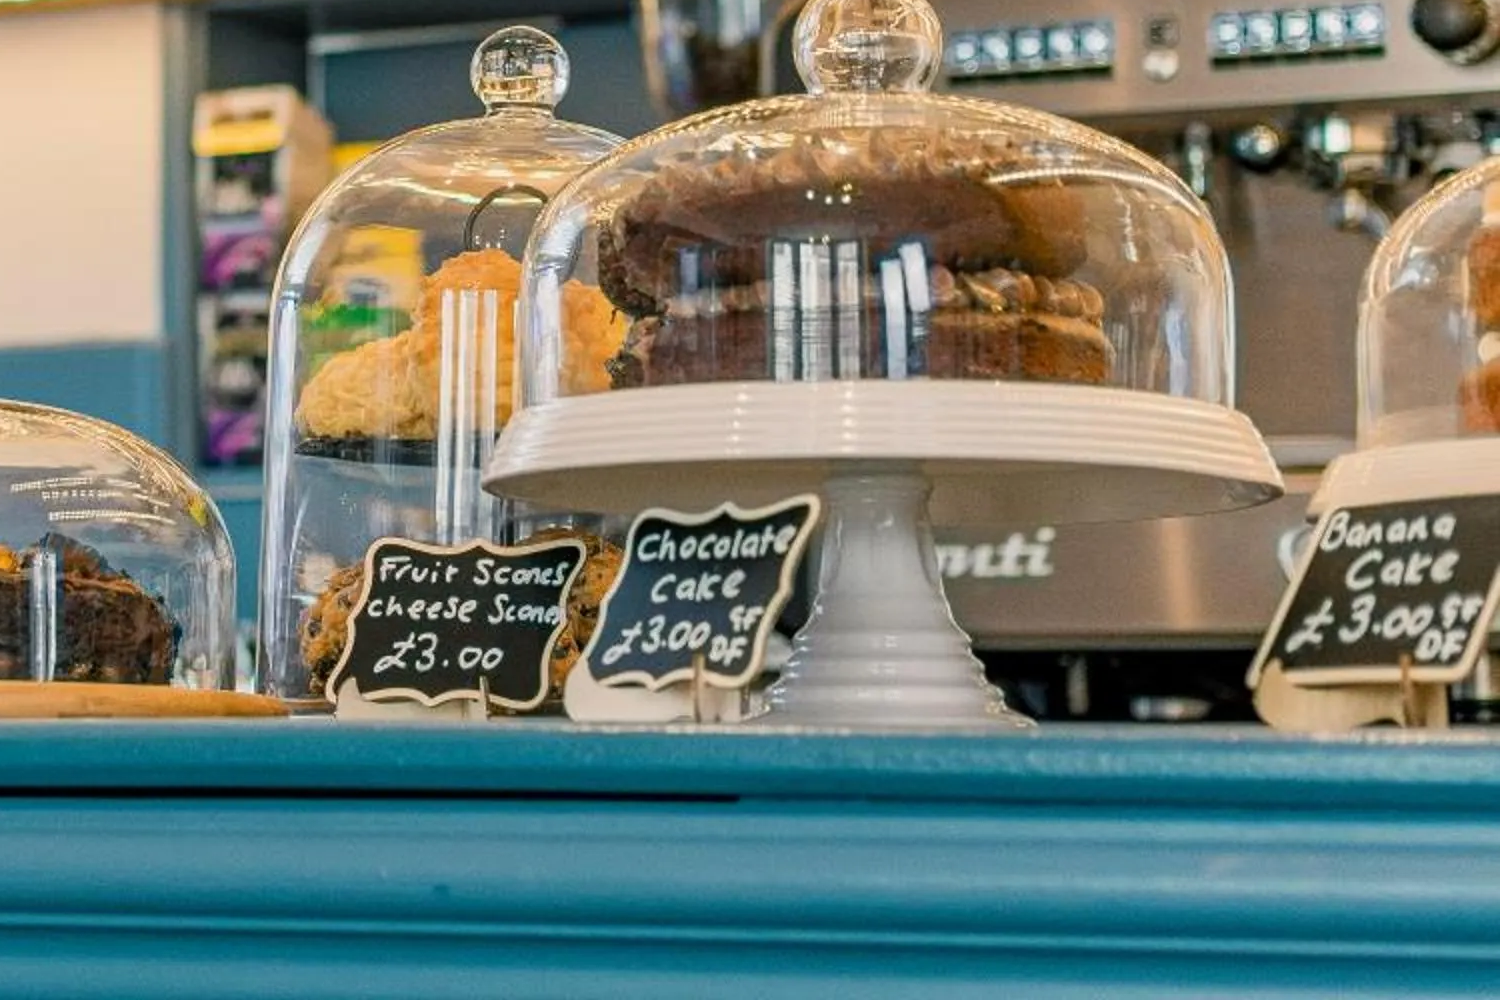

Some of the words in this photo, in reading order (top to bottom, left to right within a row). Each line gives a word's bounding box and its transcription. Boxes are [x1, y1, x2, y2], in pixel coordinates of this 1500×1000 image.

[637, 524, 797, 562] Chocolate
[1319, 510, 1457, 551] Banana
[380, 556, 459, 583] Fruit
[473, 559, 569, 586] Scones
[1346, 550, 1460, 591] Cake
[601, 615, 711, 665] £3.00
[1285, 593, 1434, 653] £3.00
[373, 632, 504, 673] £3.00
